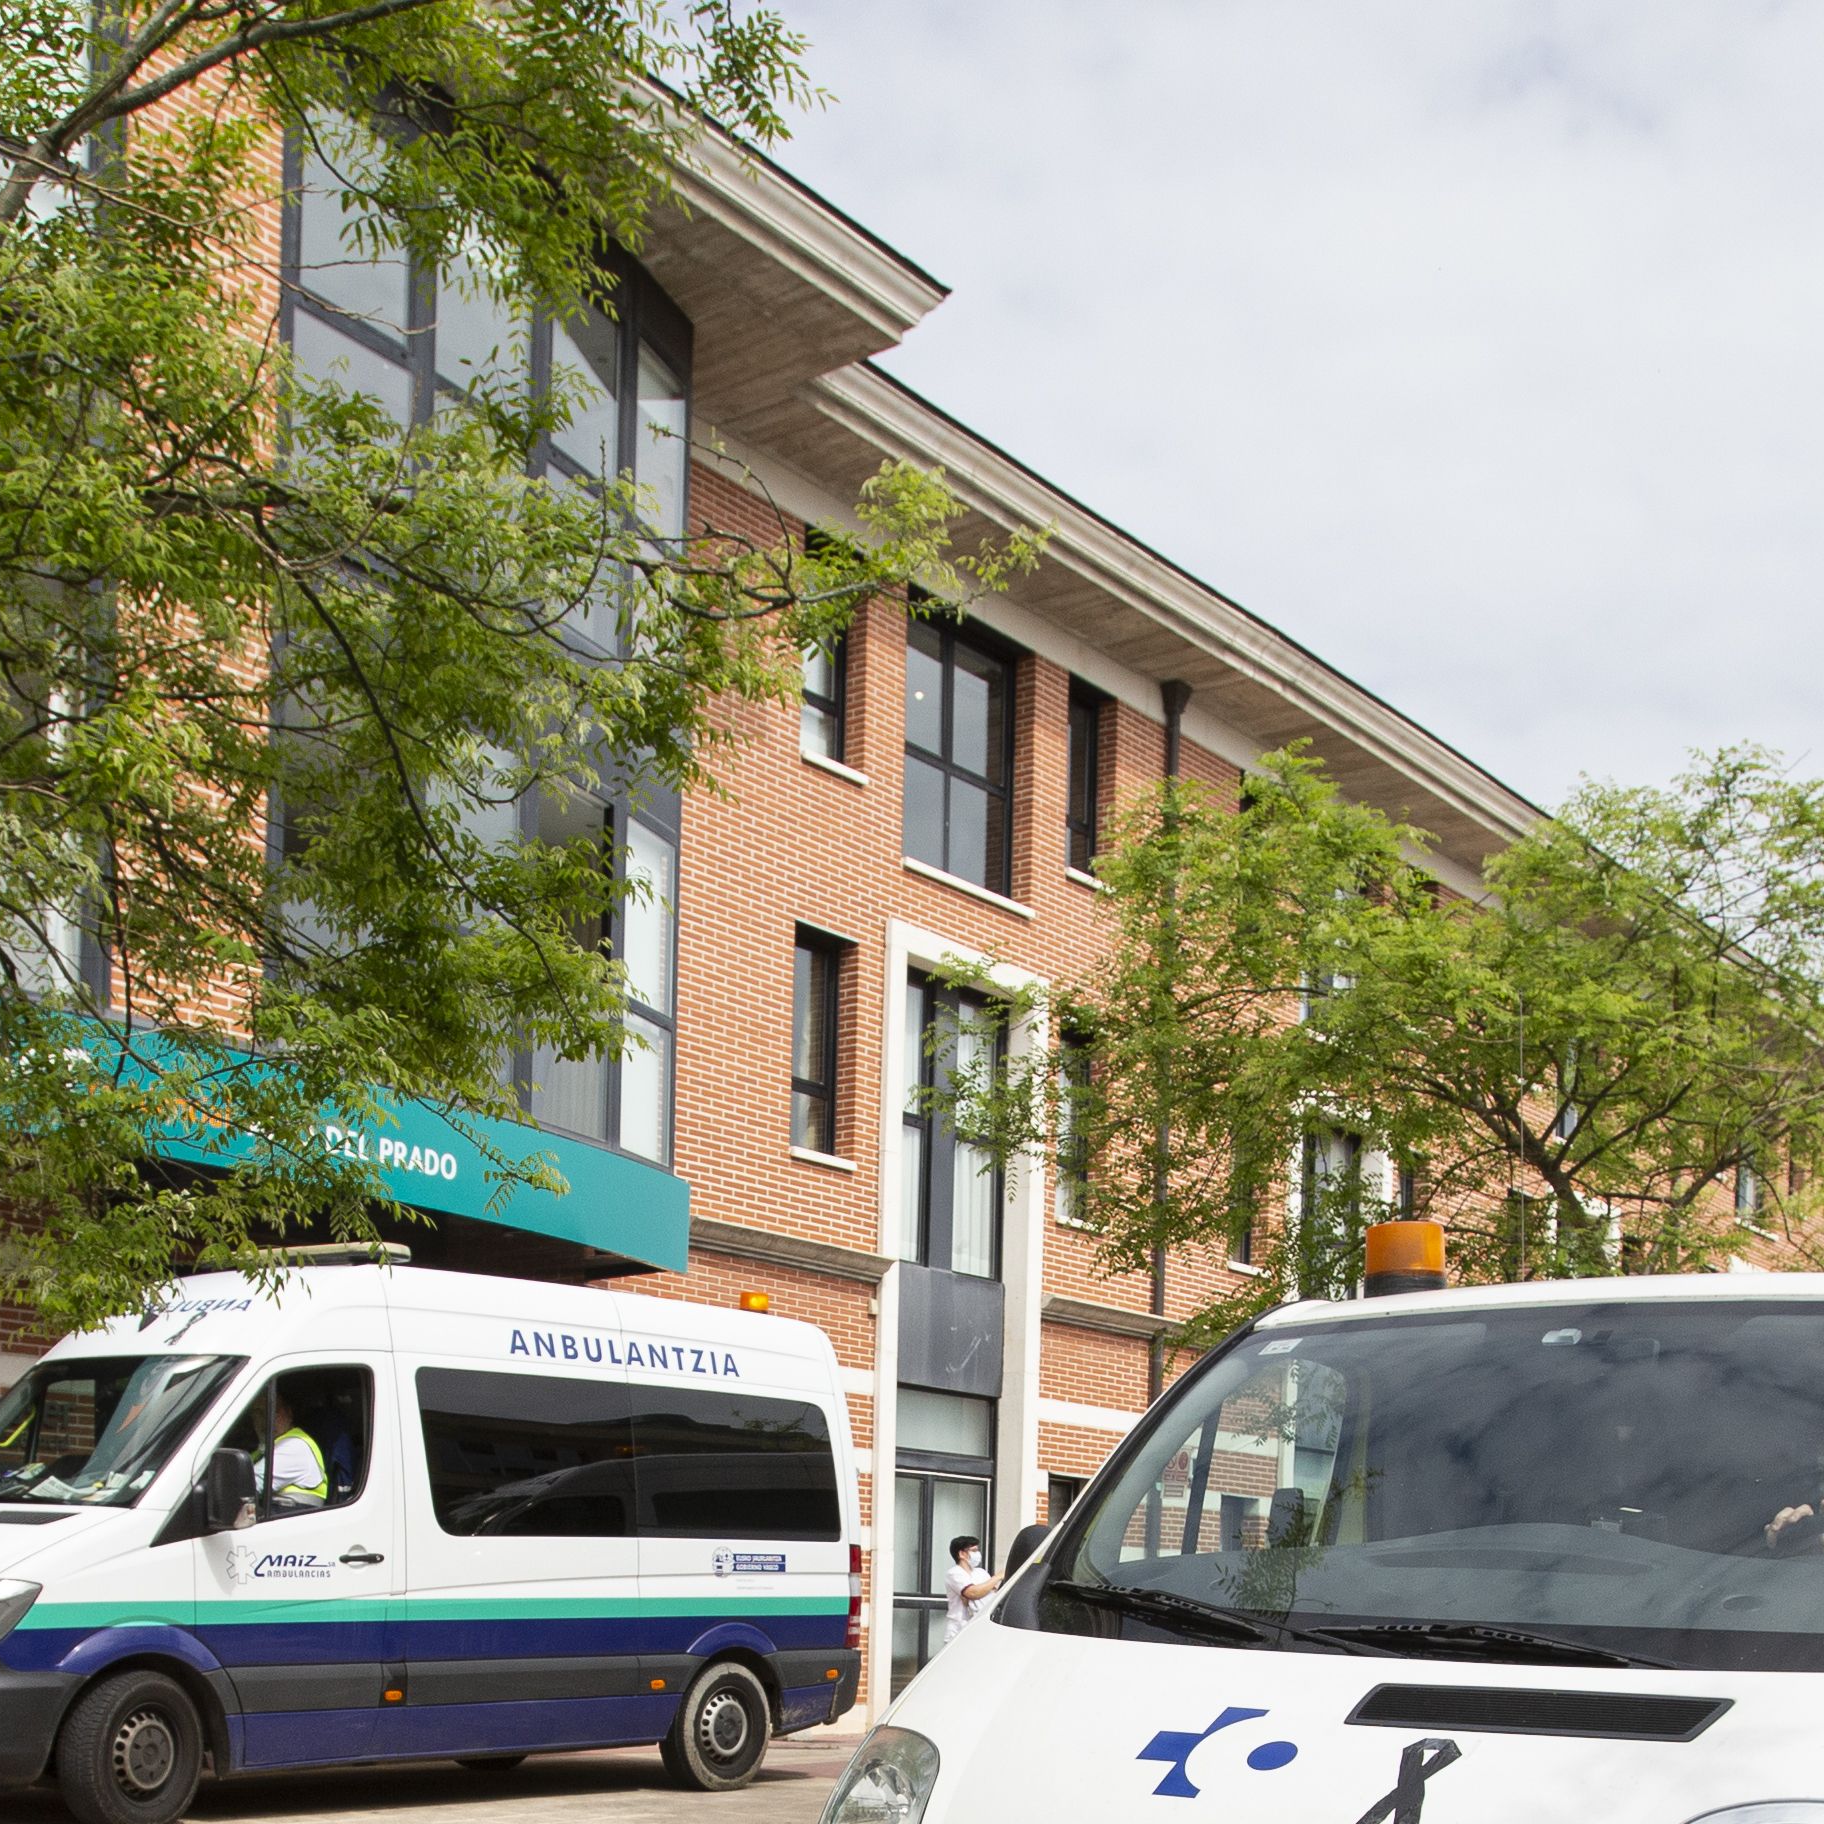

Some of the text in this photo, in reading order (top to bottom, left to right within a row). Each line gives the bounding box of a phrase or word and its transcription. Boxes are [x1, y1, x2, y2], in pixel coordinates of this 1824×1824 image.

[326, 1125, 369, 1161] DEL
[380, 1137, 457, 1180] PRADO
[509, 1329, 740, 1377] ANBULANTZIA
